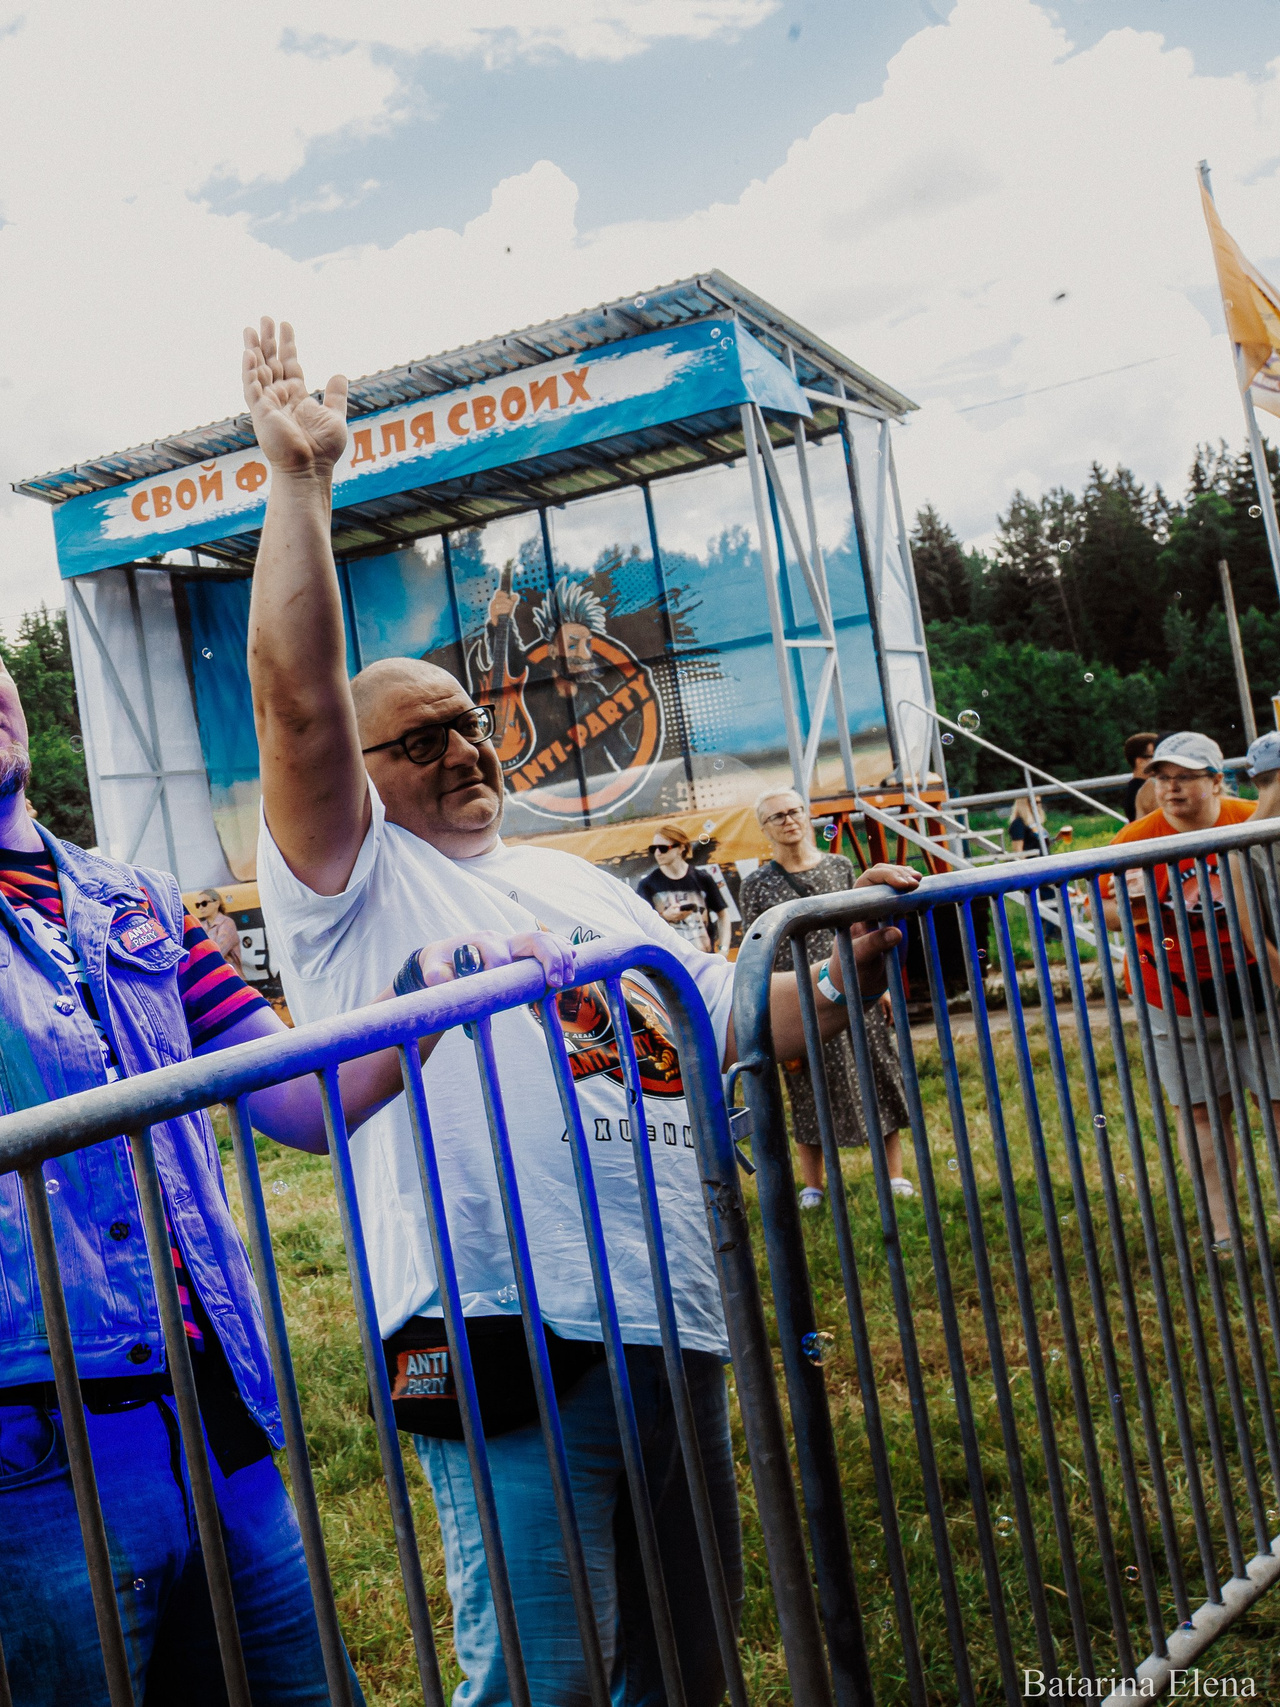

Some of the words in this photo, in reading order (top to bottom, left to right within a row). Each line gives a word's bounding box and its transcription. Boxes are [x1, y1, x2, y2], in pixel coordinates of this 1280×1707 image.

[131, 460, 224, 522] СВОЙ
[350, 411, 436, 468] ДЛЯ
[447, 366, 592, 436] СВОИХ
[510, 673, 650, 792] ANTI-PARTY
[132, 931, 158, 947] PARTY
[406, 1351, 448, 1376] ANTI
[406, 1376, 447, 1396] PARTY
